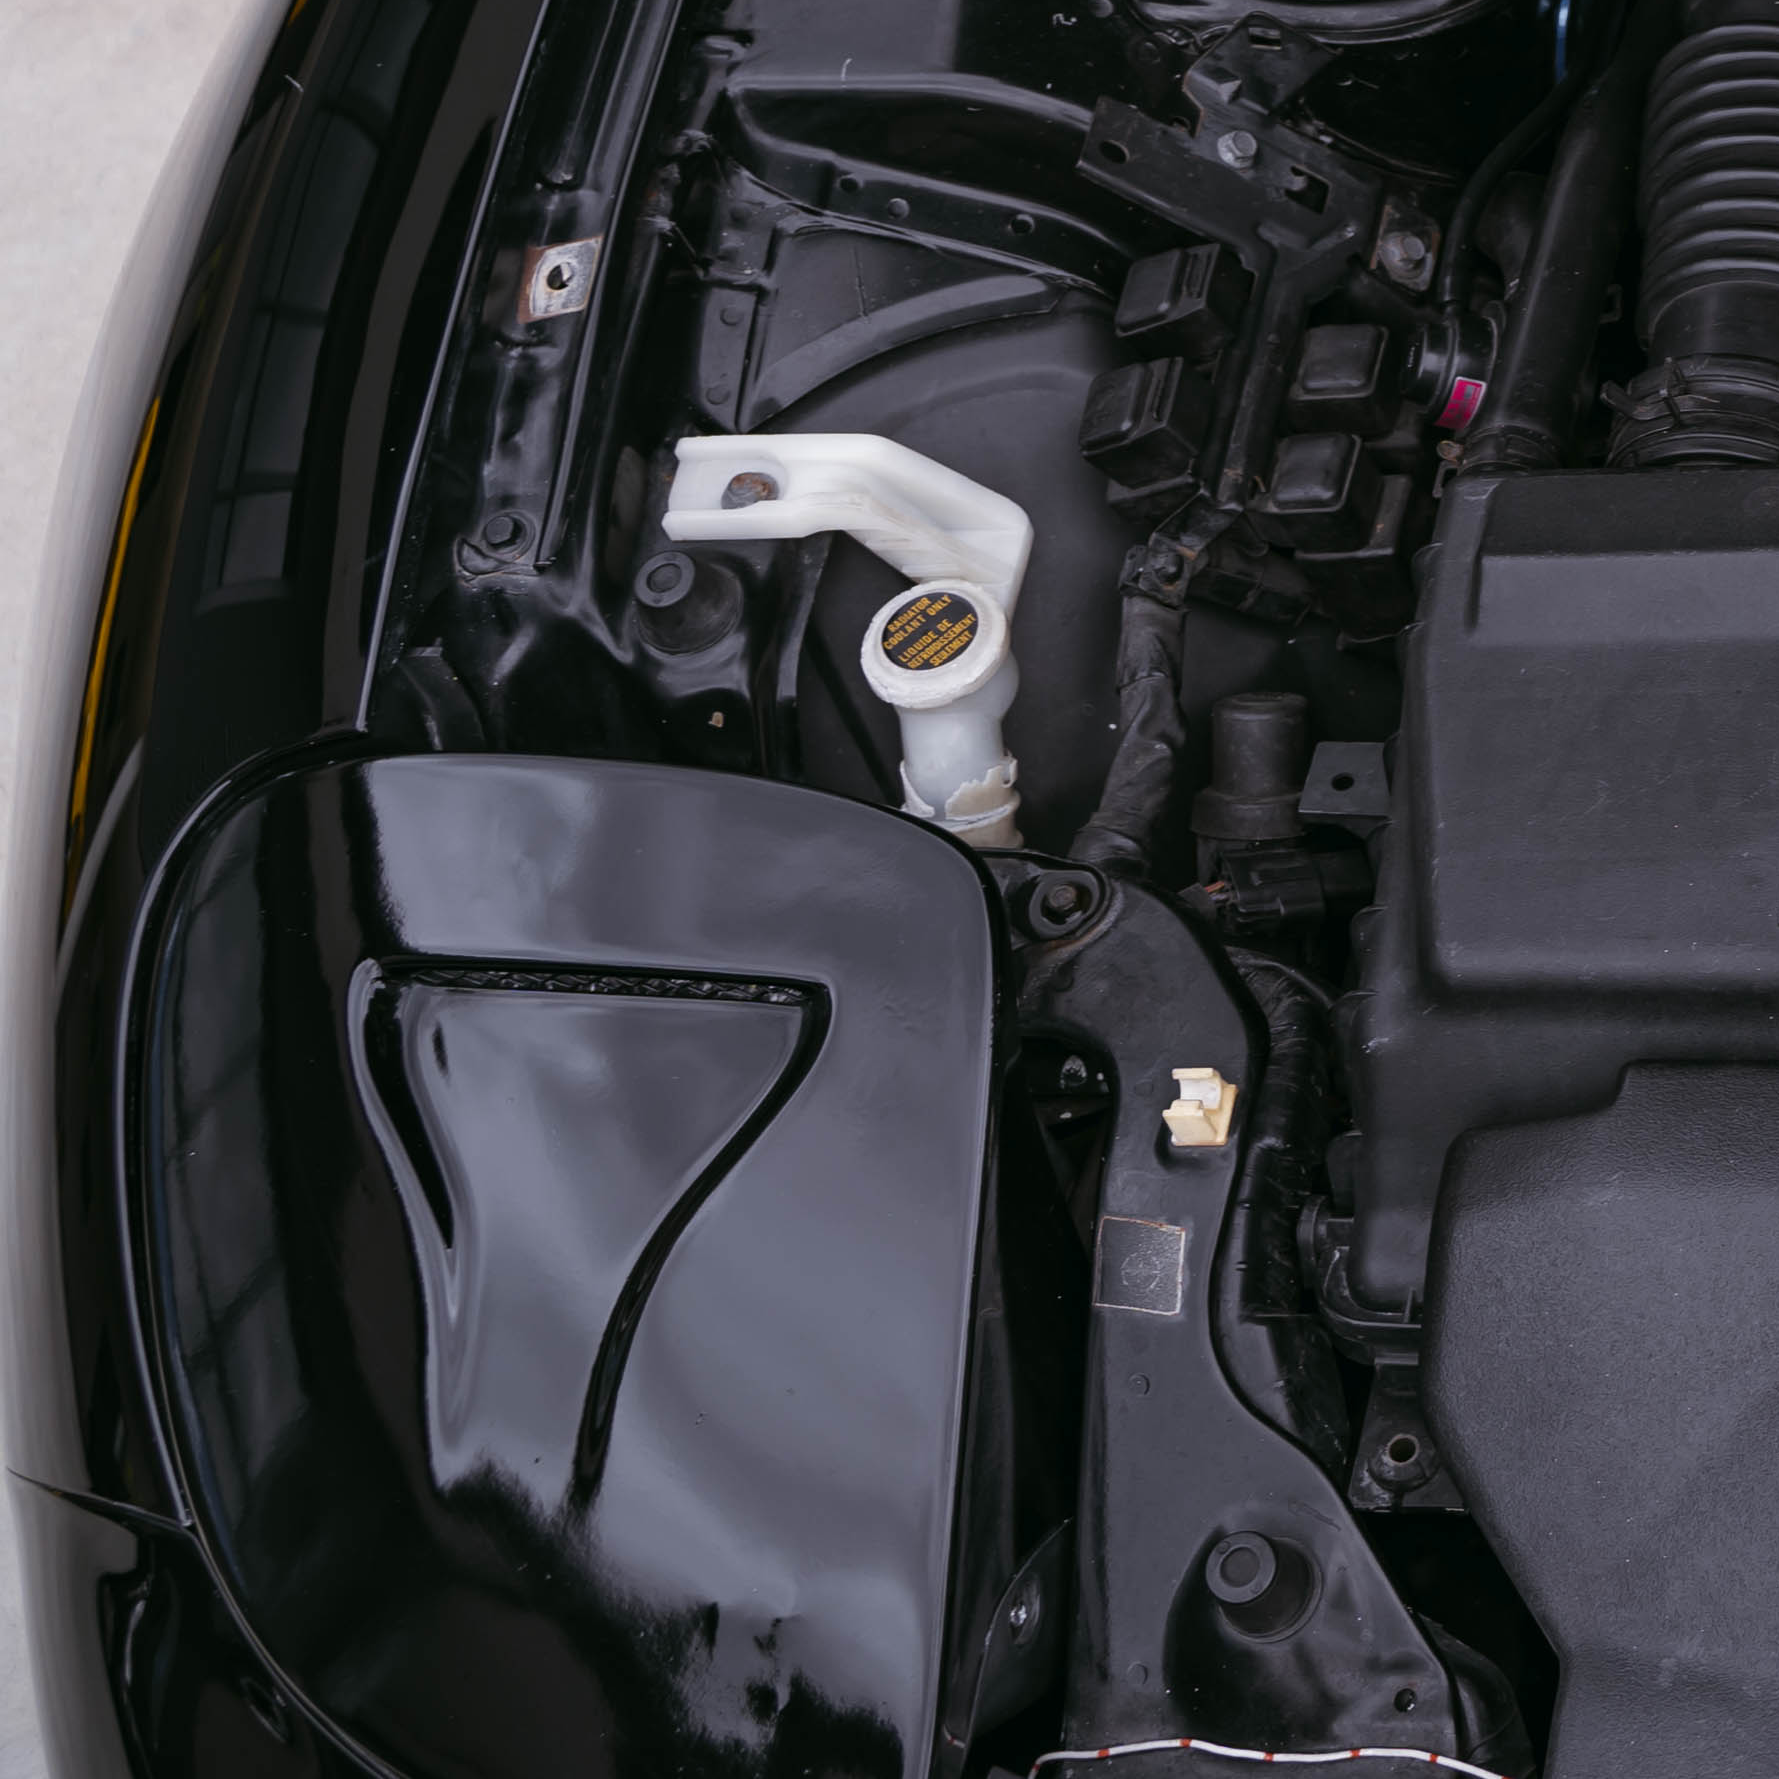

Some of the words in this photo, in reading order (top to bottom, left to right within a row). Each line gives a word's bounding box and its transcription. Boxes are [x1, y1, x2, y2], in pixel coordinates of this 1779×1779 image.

[883, 614, 927, 651] COOLANT
[925, 594, 953, 616] ONLY
[887, 596, 932, 633] RADIATOR
[898, 630, 939, 663] LIQUIDE
[936, 618, 954, 632] DE
[907, 613, 977, 669] REFROIDISSEMENT
[929, 630, 974, 667] SEULEMENT
